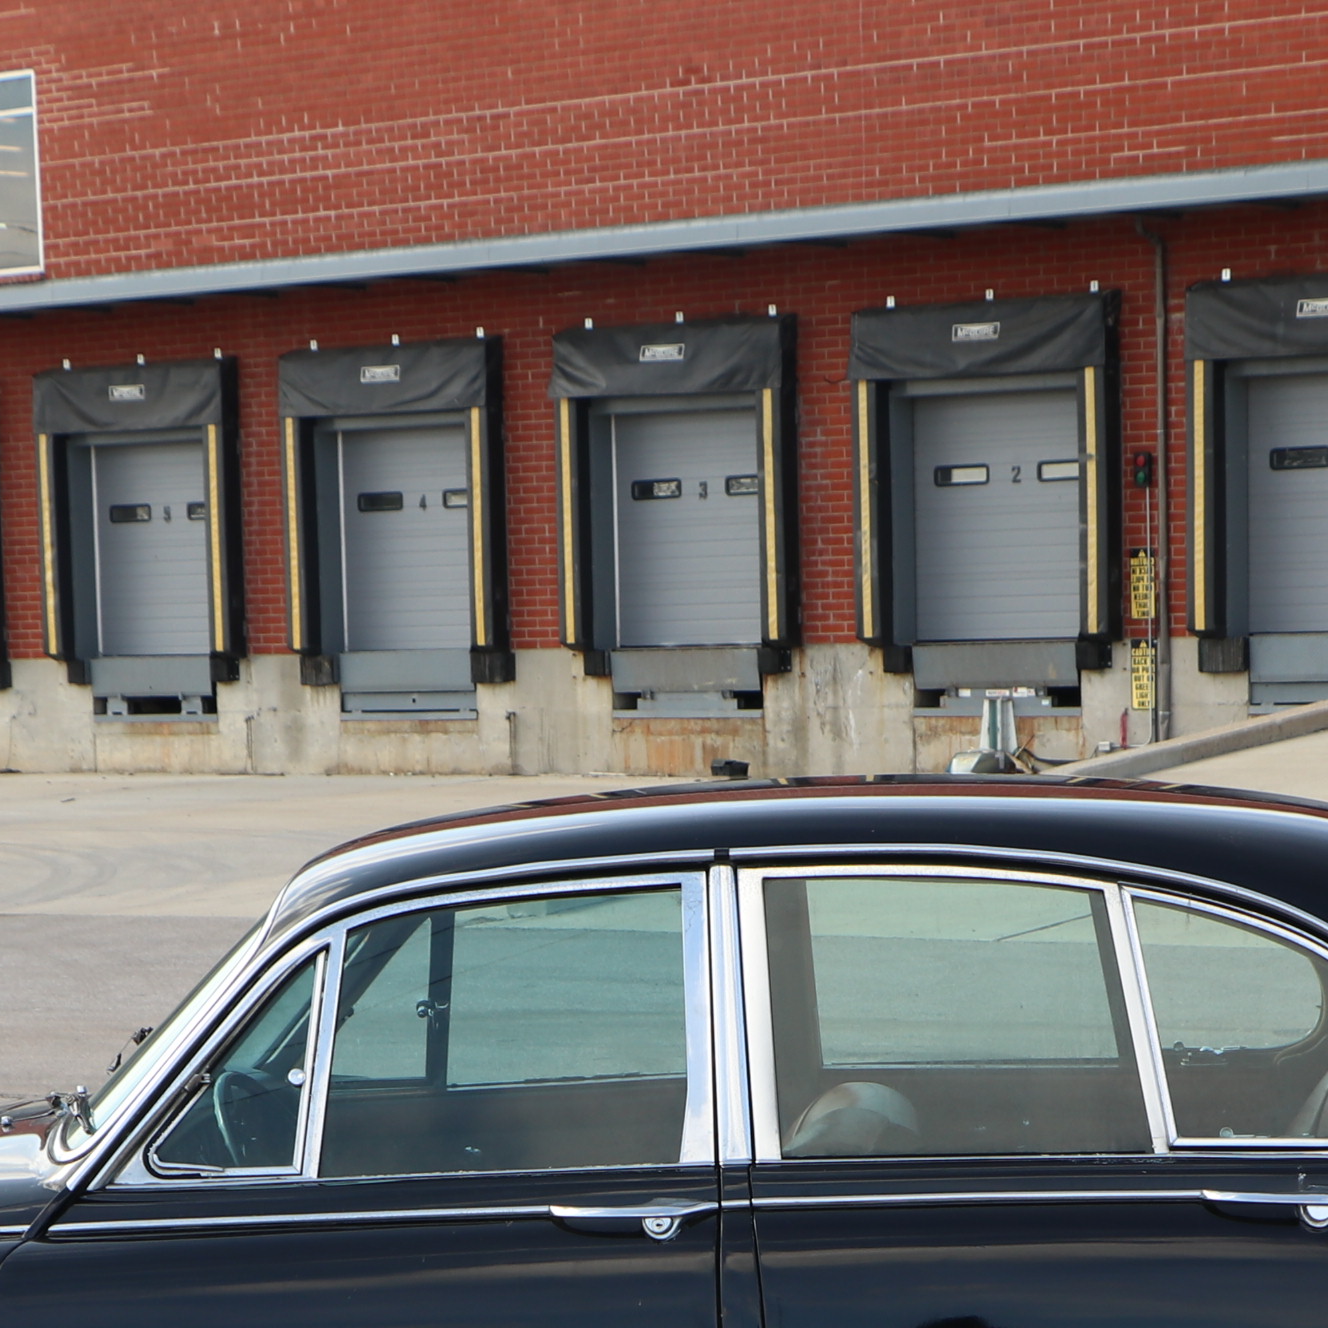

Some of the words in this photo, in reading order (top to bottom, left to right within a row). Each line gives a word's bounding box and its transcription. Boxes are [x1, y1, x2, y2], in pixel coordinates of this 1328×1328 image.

[1011, 465, 1022, 483] 2
[699, 481, 709, 500] 3
[418, 493, 427, 511] 4
